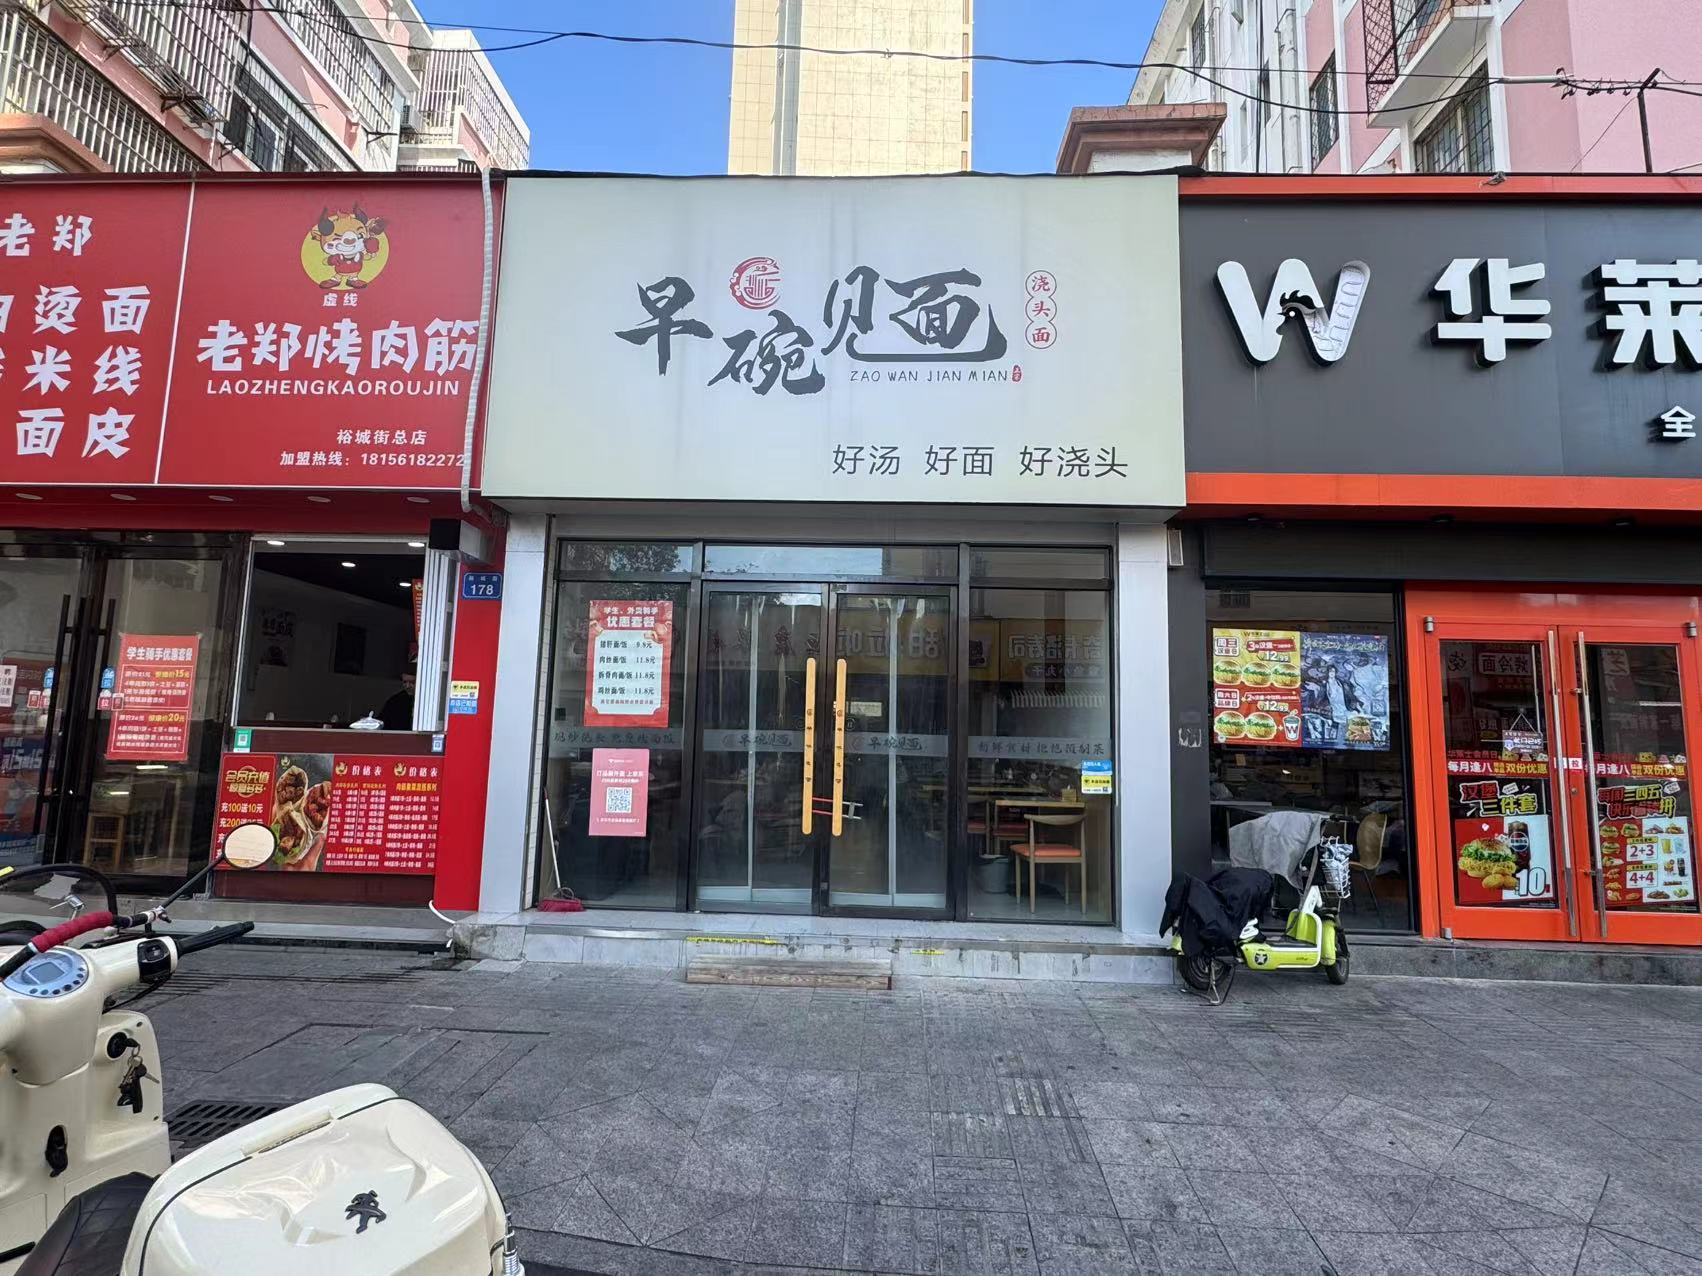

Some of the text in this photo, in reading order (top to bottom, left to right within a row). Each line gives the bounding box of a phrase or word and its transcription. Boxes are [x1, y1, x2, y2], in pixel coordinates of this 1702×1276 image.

[0, 213, 93, 257] 老郑
[1029, 271, 1052, 347] 浇头面
[1217, 258, 1371, 361] W
[614, 263, 1006, 396] 早碗见面
[197, 317, 480, 378] 老郑烤肉筋
[0, 345, 144, 397] 米线
[849, 371, 1009, 383] ZAO WAN JIAN MIAN
[206, 380, 461, 397] LAOZHENGKAOROUJIN
[16, 406, 137, 459] 面皮
[337, 429, 429, 447] 裕城街总店
[361, 453, 466, 468] 18156182272
[832, 445, 1128, 478] 好汤 好面 好浇头
[470, 584, 494, 596] 178
[1461, 782, 1498, 801] 汉堡
[1483, 794, 1537, 814] 三件套
[1629, 844, 1655, 858] 2+3
[1516, 866, 1547, 897] 10
[1629, 871, 1655, 884] 4+4
